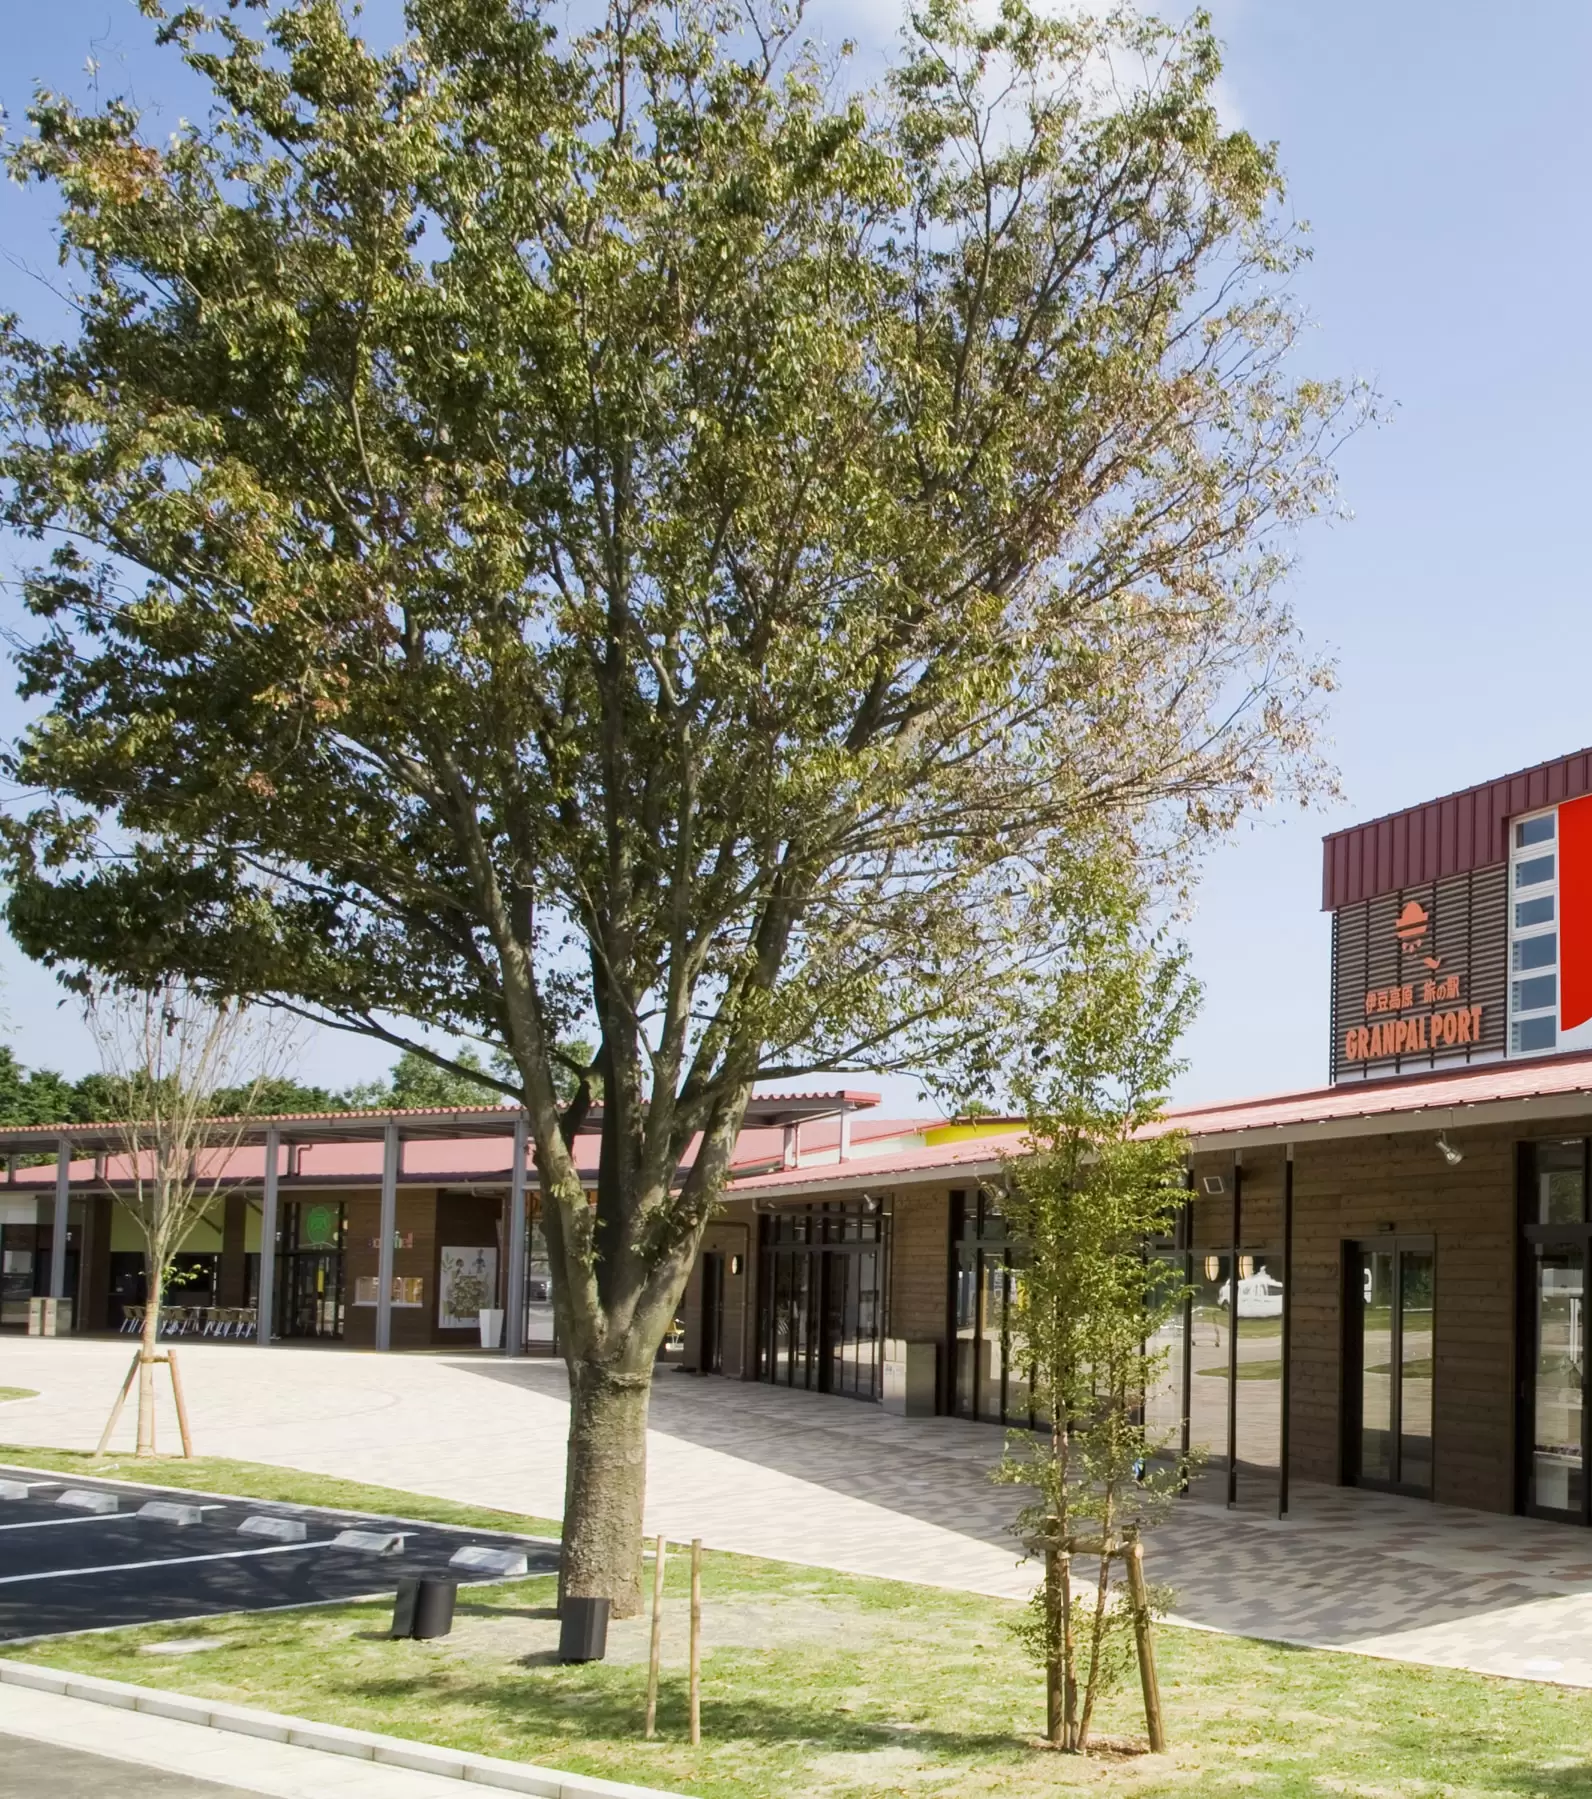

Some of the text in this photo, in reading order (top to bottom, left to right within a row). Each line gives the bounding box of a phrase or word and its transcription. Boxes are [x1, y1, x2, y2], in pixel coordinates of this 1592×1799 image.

[1366, 975, 1460, 1014] 伊豆高原 旅の駅
[1345, 1006, 1482, 1060] GRANPAL PORT
